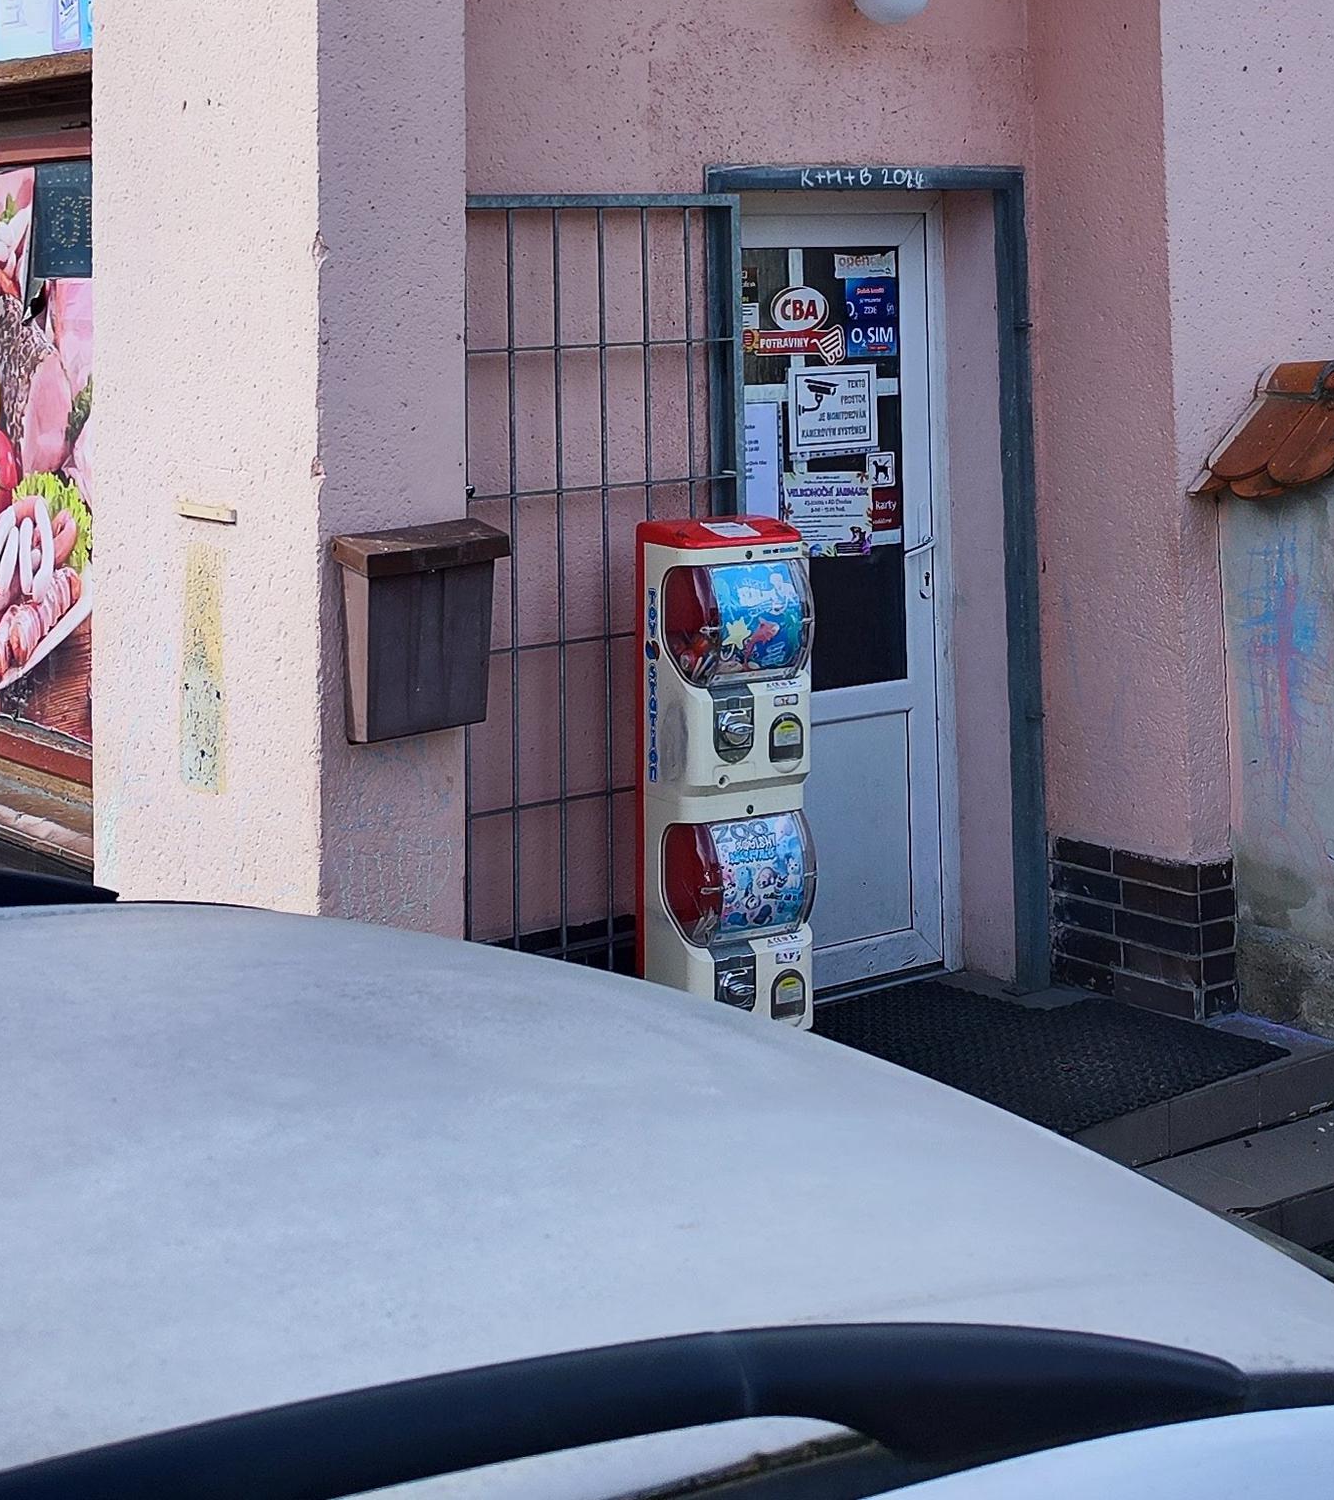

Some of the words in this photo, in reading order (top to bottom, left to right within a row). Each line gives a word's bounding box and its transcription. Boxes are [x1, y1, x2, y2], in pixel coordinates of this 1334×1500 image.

[759, 337, 809, 349] POTRAVINY
[867, 326, 893, 344] SIM
[647, 587, 659, 639] TOY
